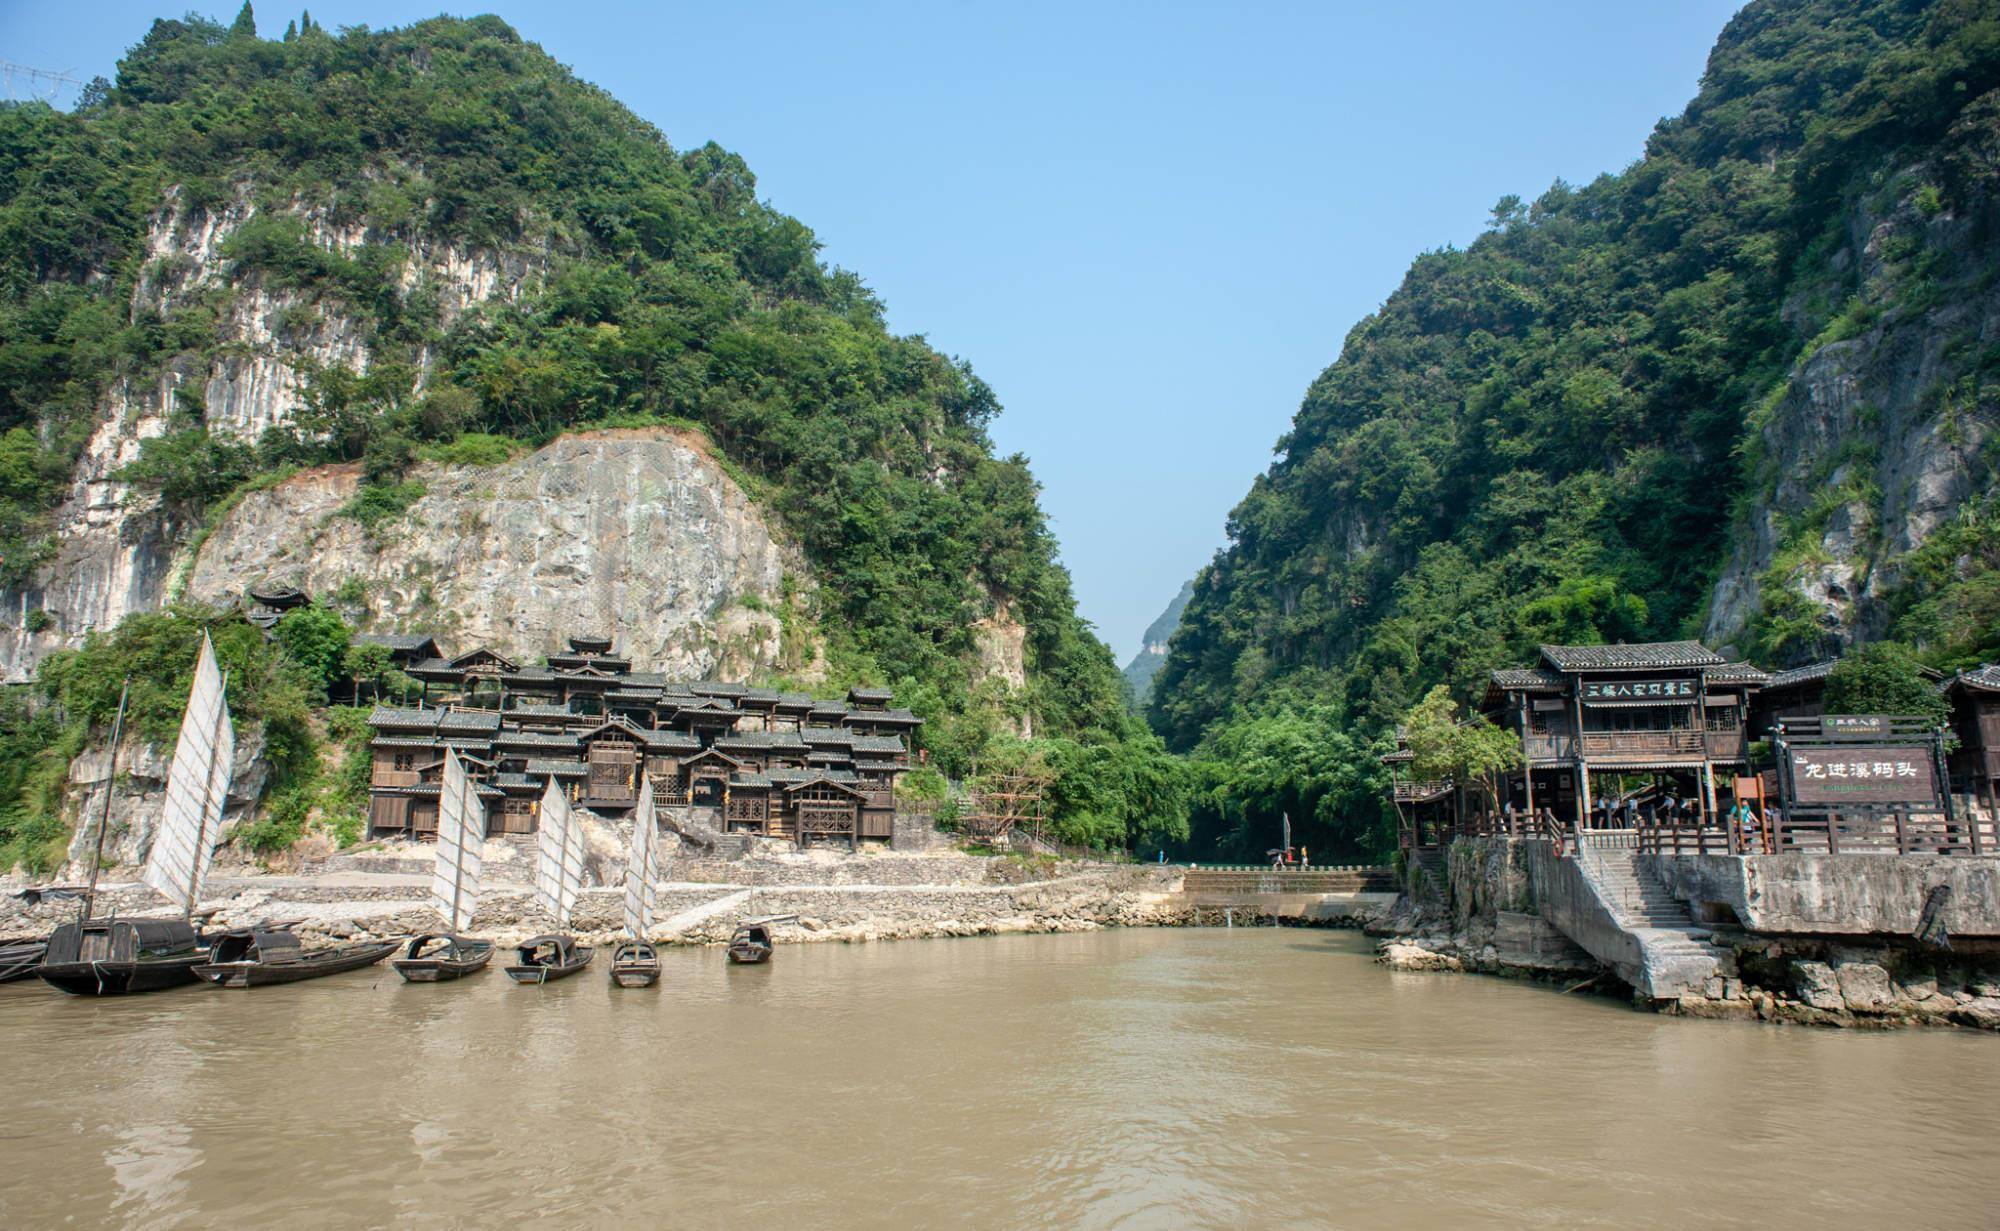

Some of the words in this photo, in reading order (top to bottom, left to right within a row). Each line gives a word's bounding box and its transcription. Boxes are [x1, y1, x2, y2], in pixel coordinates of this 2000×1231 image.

[1805, 762, 1917, 779] 龙进溪码头
